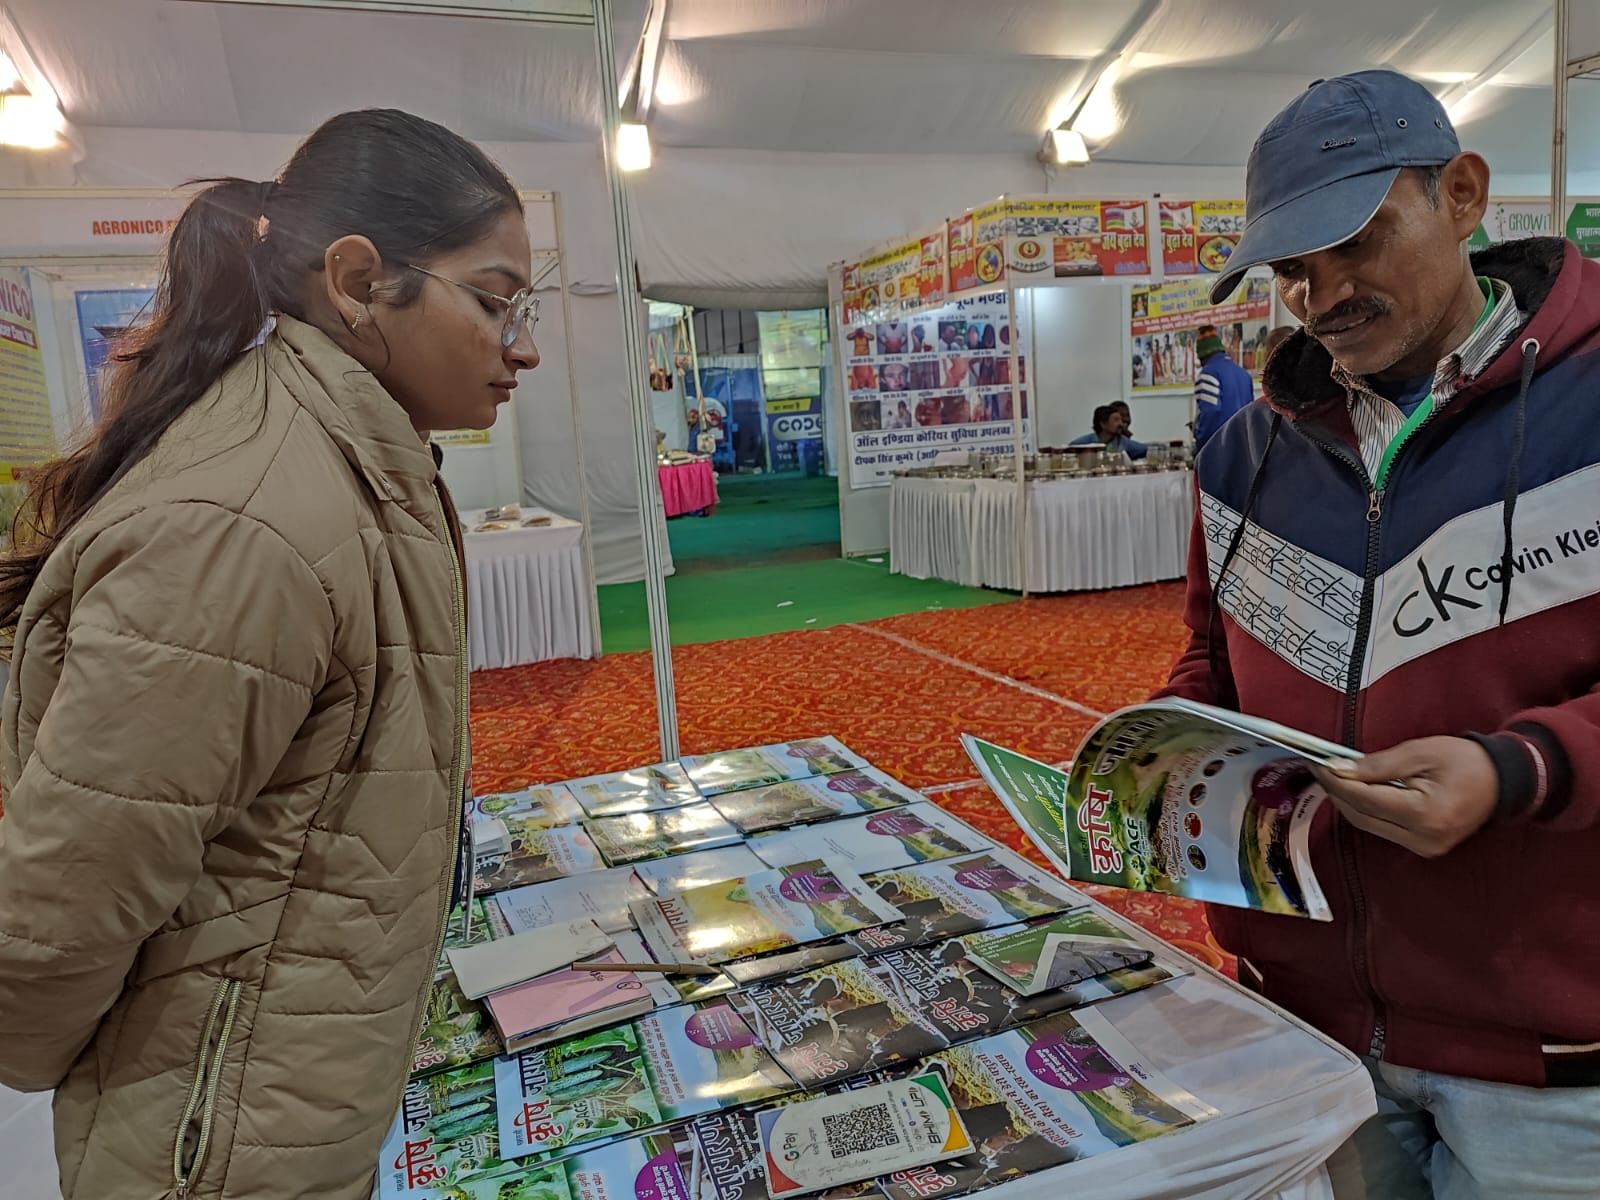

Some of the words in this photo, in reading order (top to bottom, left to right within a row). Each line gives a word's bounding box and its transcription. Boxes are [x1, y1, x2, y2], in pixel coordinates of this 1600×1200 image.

[92, 220, 164, 235] AGRONICO
[857, 432, 879, 448] ऑल
[1465, 547, 1553, 590] Cavin
[1078, 784, 1123, 874] कृषि
[1127, 817, 1140, 855] ACF
[884, 951, 941, 1001] जागरण
[930, 998, 989, 1032] कृषि
[792, 1042, 848, 1079] कृषि
[574, 1100, 589, 1119] ACF
[1023, 1087, 1040, 1104] का
[513, 1100, 564, 1144] कृषि
[785, 1132, 798, 1149] Pay
[395, 1136, 446, 1190] कृषि
[459, 1139, 475, 1158] ACF
[692, 1117, 745, 1200] जागरण
